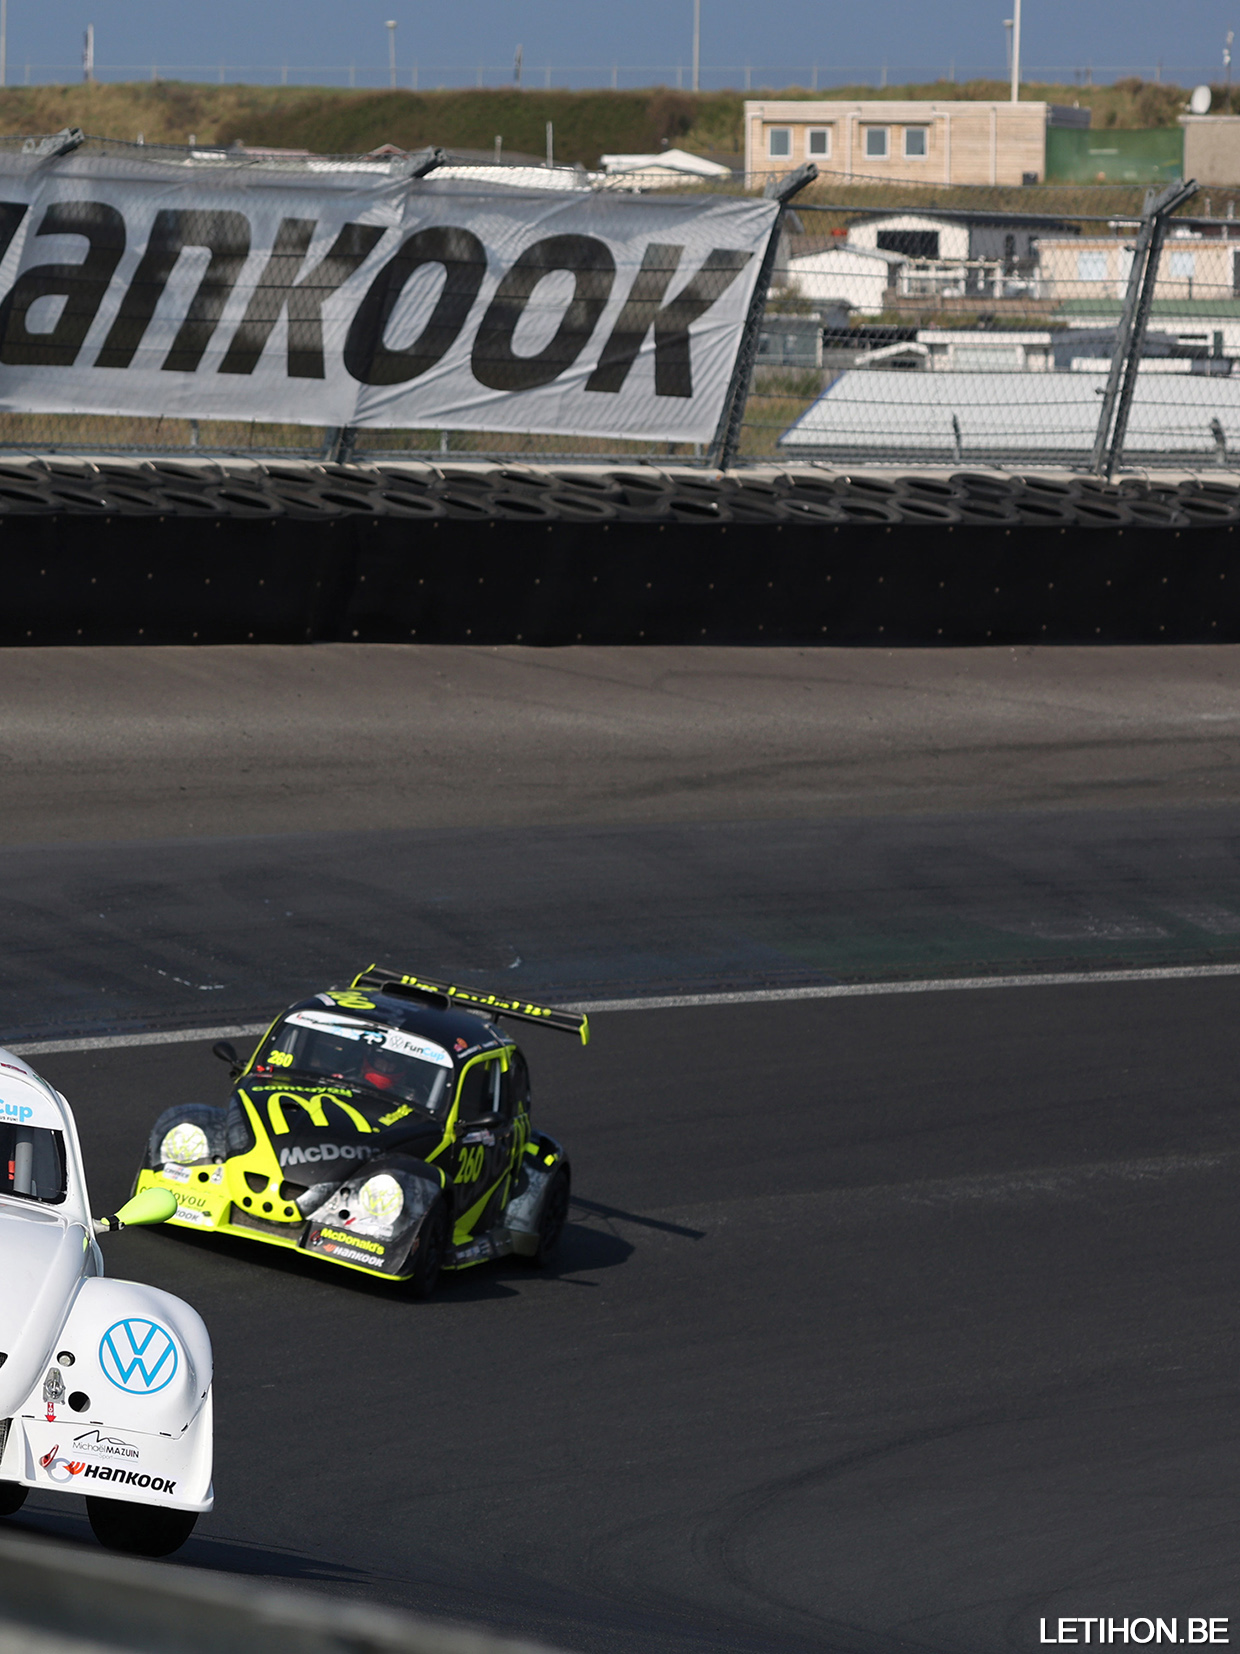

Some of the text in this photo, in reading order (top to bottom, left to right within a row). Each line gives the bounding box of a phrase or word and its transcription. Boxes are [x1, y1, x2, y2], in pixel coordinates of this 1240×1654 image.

[267, 1049, 294, 1068] 260
[403, 1040, 446, 1062] FunCup
[453, 1144, 485, 1184] 260
[320, 1227, 386, 1256] McDonald's
